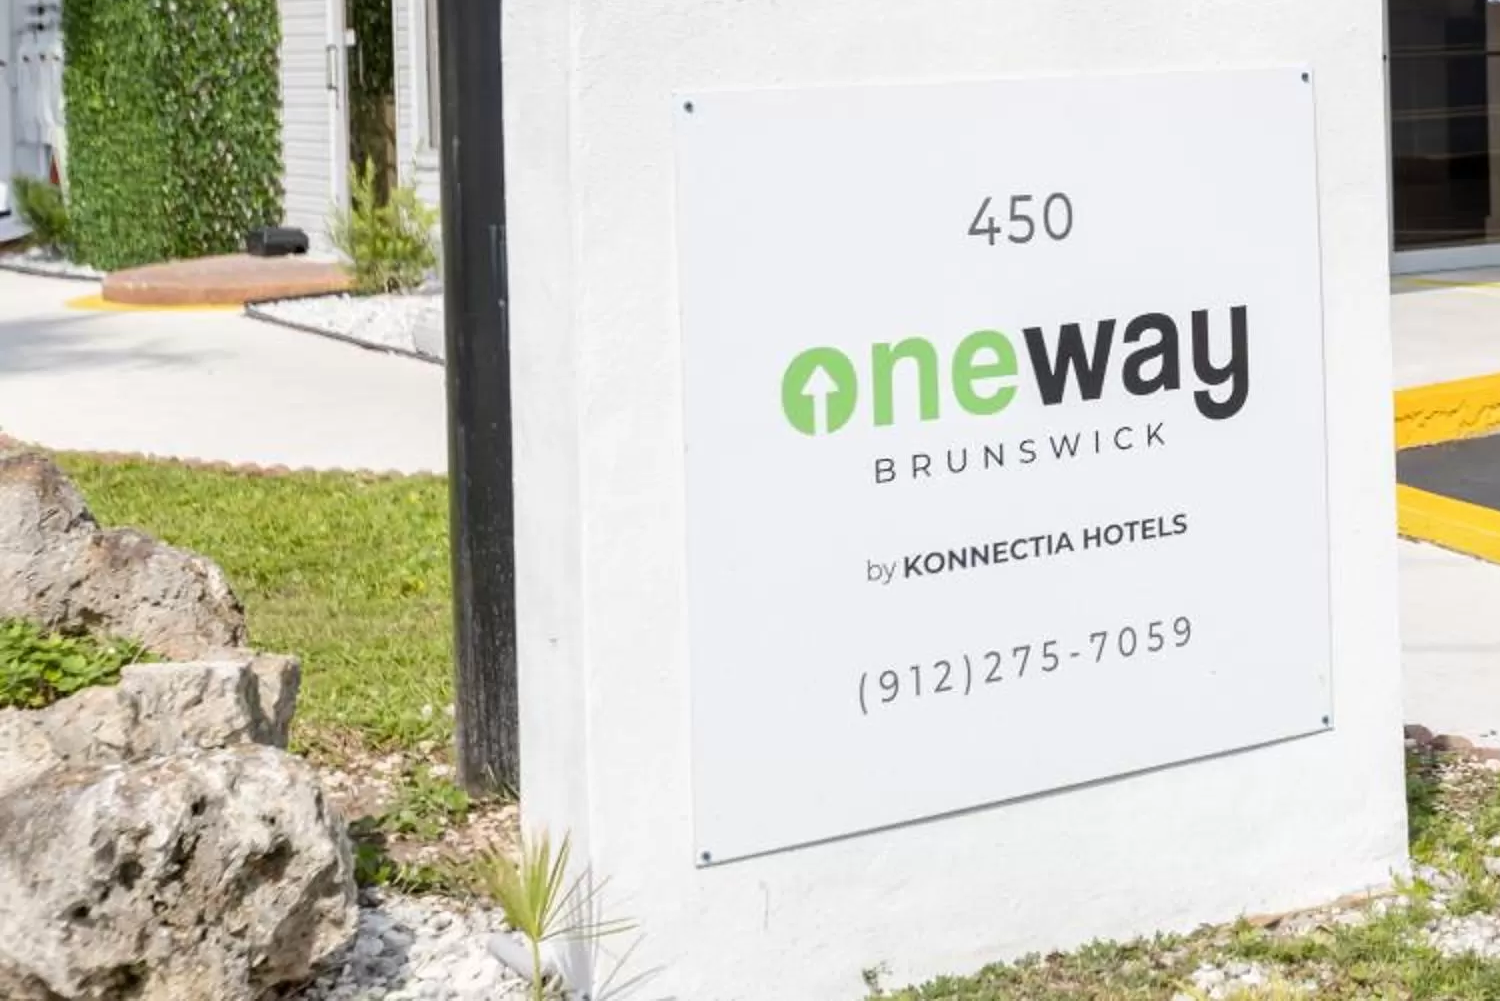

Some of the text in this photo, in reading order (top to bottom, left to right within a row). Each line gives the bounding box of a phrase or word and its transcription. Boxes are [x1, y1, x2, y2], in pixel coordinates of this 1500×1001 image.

[967, 191, 1073, 246] 450
[781, 304, 1249, 436] oneway
[873, 422, 1166, 484] BRUNSWICK
[867, 513, 1188, 585] by KONNECTIA HOTELS
[859, 616, 1192, 715] (912)275-7059
